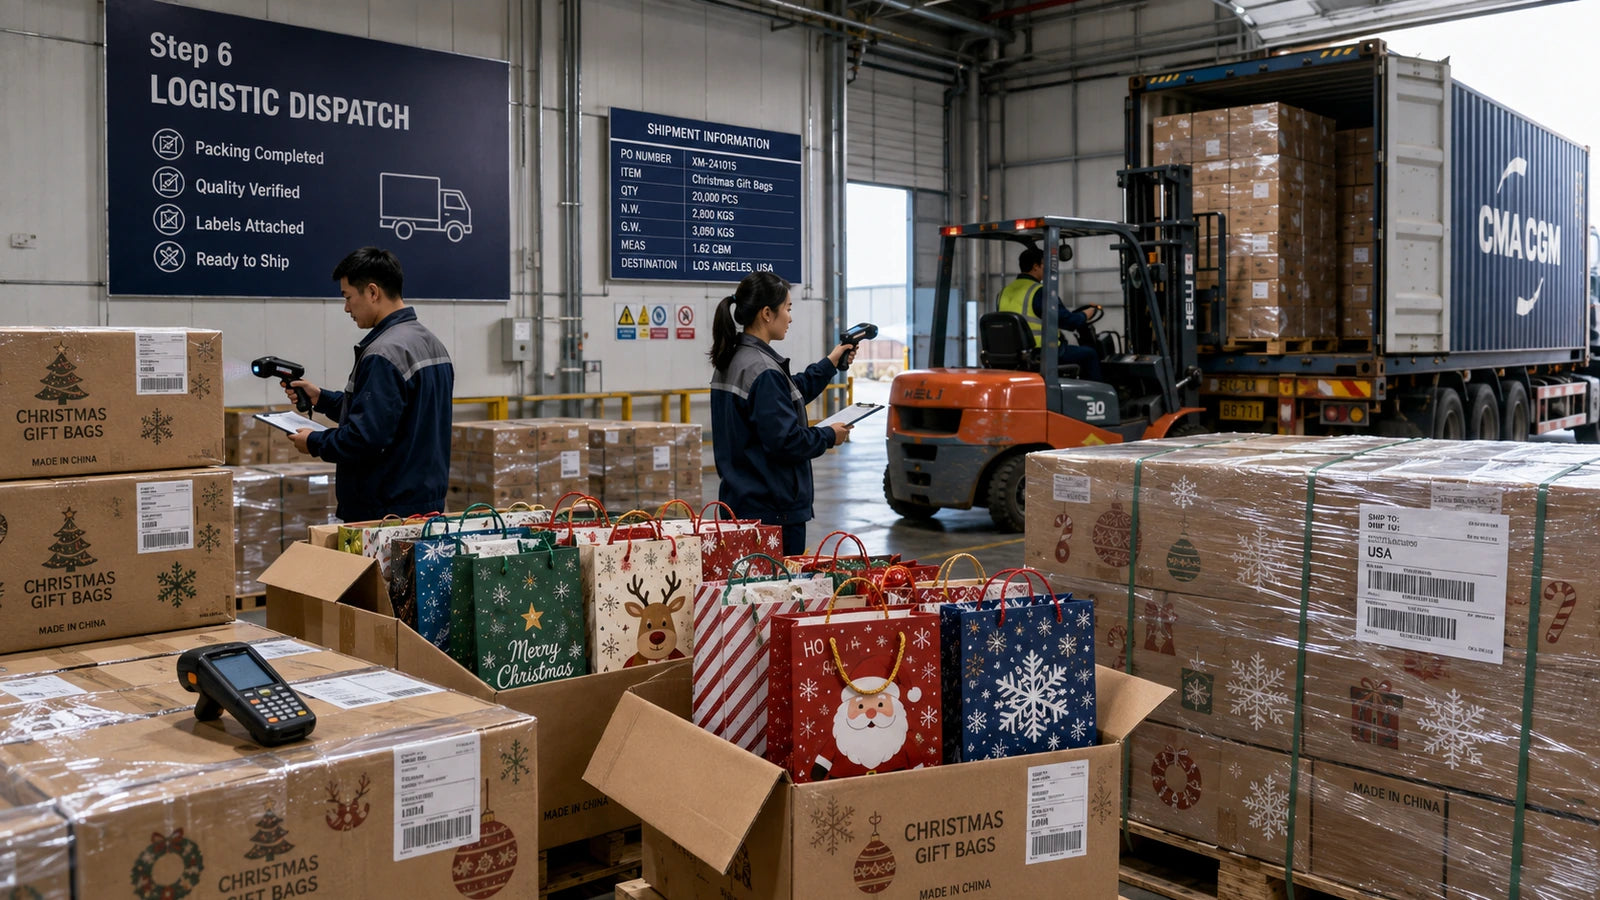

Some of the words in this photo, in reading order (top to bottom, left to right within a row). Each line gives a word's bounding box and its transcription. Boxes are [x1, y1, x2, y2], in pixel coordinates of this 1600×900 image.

[150, 32, 209, 68] Step
[217, 42, 232, 67] 6
[151, 74, 279, 116] LOGISTIC
[290, 91, 410, 131] DISPATCH
[648, 123, 700, 141] SHIPMENT
[704, 130, 770, 150] INFORMATION
[196, 140, 250, 162] Packing
[254, 146, 324, 166] Completed
[621, 148, 633, 159] PO
[635, 150, 672, 164] NUMBER
[621, 167, 641, 178] ITEM
[196, 178, 245, 198] Quality
[249, 182, 300, 200] Verified
[621, 185, 638, 196] QTY
[692, 174, 734, 188] Christmas
[736, 178, 752, 189] Gift
[753, 180, 774, 193] Bags
[692, 191, 720, 203] 20,000
[721, 194, 739, 204] PCS
[621, 203, 641, 214] N.W.
[717, 211, 735, 221] KGS
[196, 215, 241, 234] Labels
[245, 218, 304, 236] Attached
[621, 221, 641, 232] G.W.
[717, 228, 735, 238] KGS
[621, 239, 646, 250] MEAS
[1479, 205, 1523, 260] CMA
[1525, 217, 1561, 266] CGM
[692, 243, 710, 254] 1.62
[712, 244, 732, 254] CBM
[197, 252, 239, 270] Ready
[242, 254, 256, 268] to
[261, 253, 290, 271] Ship
[621, 257, 678, 269] DESTINATION
[693, 260, 710, 271] LOS
[712, 261, 754, 273] ANGELES,
[756, 263, 774, 273] USA
[16, 407, 107, 424] CHRISTMAS
[1086, 401, 1105, 416] 30
[24, 427, 59, 441] GIFT
[64, 424, 104, 439] BAGS
[32, 456, 57, 467] MADE
[60, 456, 70, 465] IN
[71, 455, 97, 464] CHINA
[1368, 546, 1392, 560] USA
[24, 571, 116, 594] CHRISTMAS
[31, 592, 67, 609] GIFT
[72, 588, 113, 604] BAGS
[39, 623, 65, 635] MADE
[67, 622, 76, 631] IN
[78, 619, 106, 630] CHINA
[508, 639, 562, 664] Merry
[803, 638, 824, 658] HO
[497, 661, 574, 689] Christmas
[1354, 782, 1385, 799] MADE
[1388, 791, 1400, 803] IN
[1403, 794, 1440, 814] CHINA
[544, 806, 570, 822] MADE
[571, 803, 580, 815] IN
[582, 796, 609, 811] CHINA
[905, 810, 1004, 842] CHRISTMAS
[915, 843, 950, 865] GIFT
[955, 835, 996, 858] BAGS
[218, 854, 319, 893] CHRISTMAS
[272, 875, 318, 900] BAGS
[919, 887, 948, 900] MADE
[950, 884, 960, 897] IN
[962, 879, 991, 894] CHINA
